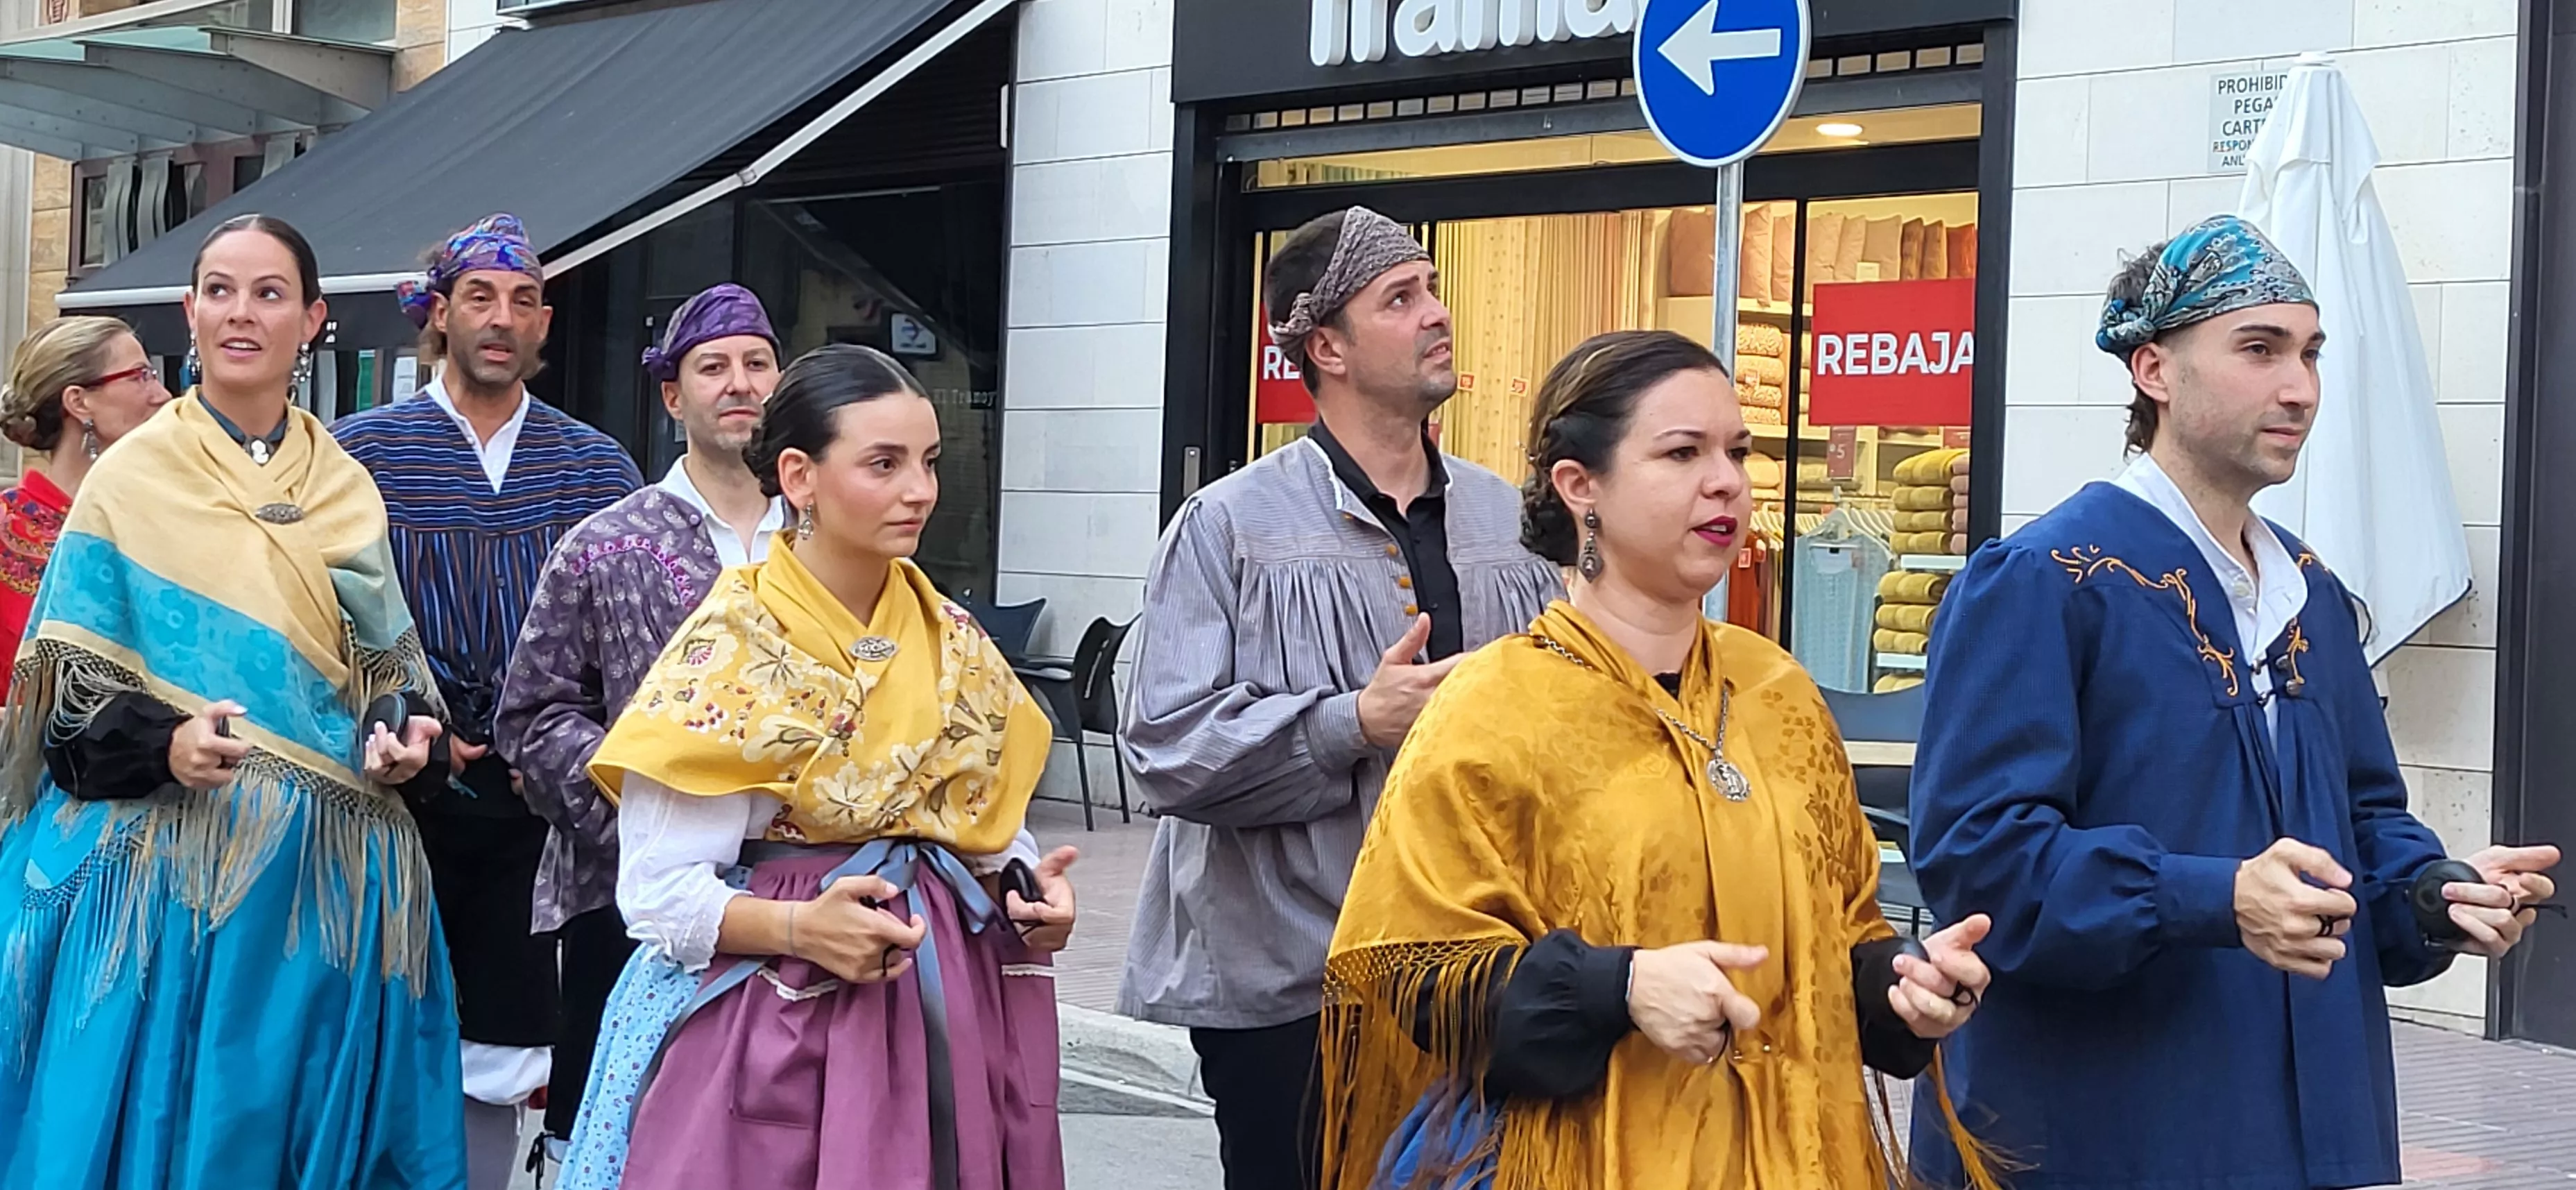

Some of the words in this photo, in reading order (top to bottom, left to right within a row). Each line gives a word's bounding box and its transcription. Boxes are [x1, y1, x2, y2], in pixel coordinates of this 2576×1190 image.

[2234, 96, 2278, 114] PEGA
[2222, 117, 2266, 137] CART
[1817, 332, 1974, 375] REBAJA
